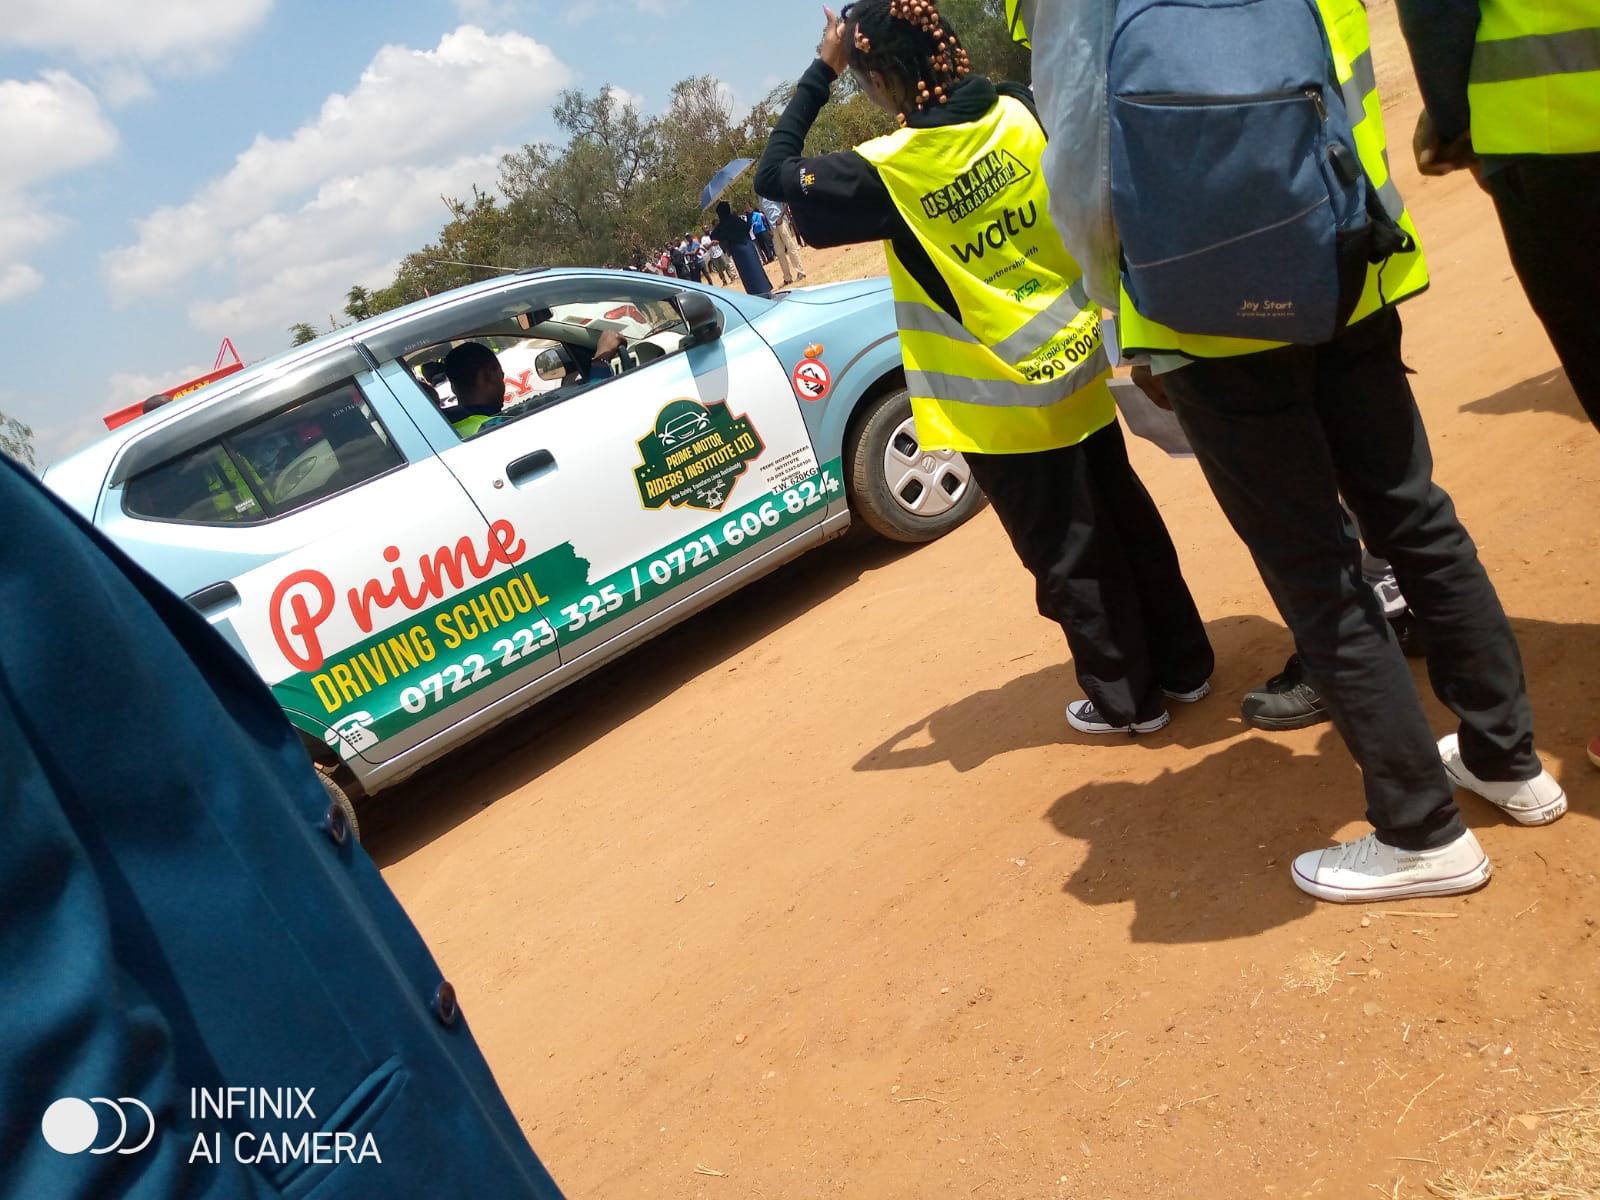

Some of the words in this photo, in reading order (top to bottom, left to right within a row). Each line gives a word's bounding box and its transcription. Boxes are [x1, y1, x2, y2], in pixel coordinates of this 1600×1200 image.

[922, 152, 1001, 217] USALAMA
[950, 200, 1037, 264] watu
[1263, 300, 1293, 310] Start
[645, 470, 686, 499] RIDERS
[684, 443, 737, 480] INSTITUTE
[734, 431, 755, 454] LTD
[665, 446, 694, 471] PRIME
[692, 432, 725, 456] MOTOR
[790, 467, 817, 485] 620KG
[269, 519, 526, 673] Prime
[399, 654, 492, 715] 0722
[492, 618, 558, 667] 223
[560, 583, 623, 631] 325
[649, 533, 719, 585] 0721
[722, 501, 780, 546] 606
[782, 469, 840, 514] 824
[311, 626, 436, 714] DRIVING
[436, 572, 550, 649] SCHOOL
